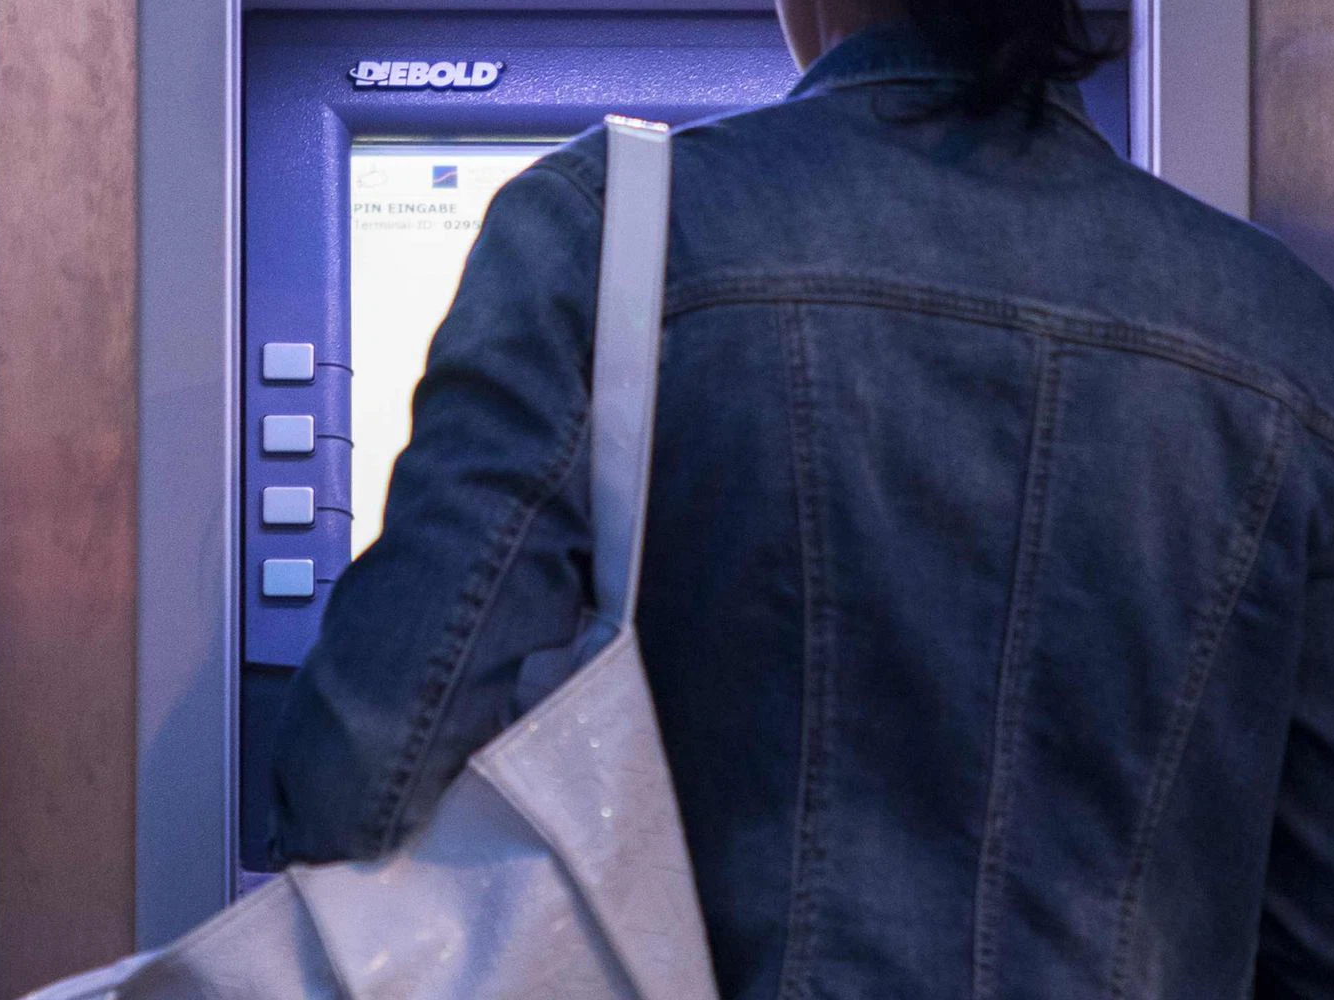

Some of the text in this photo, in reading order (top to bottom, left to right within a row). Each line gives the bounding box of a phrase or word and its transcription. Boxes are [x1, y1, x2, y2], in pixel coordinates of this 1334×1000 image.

[353, 61, 499, 87] DIEBOLD
[353, 203, 457, 214] PIN EINGABE
